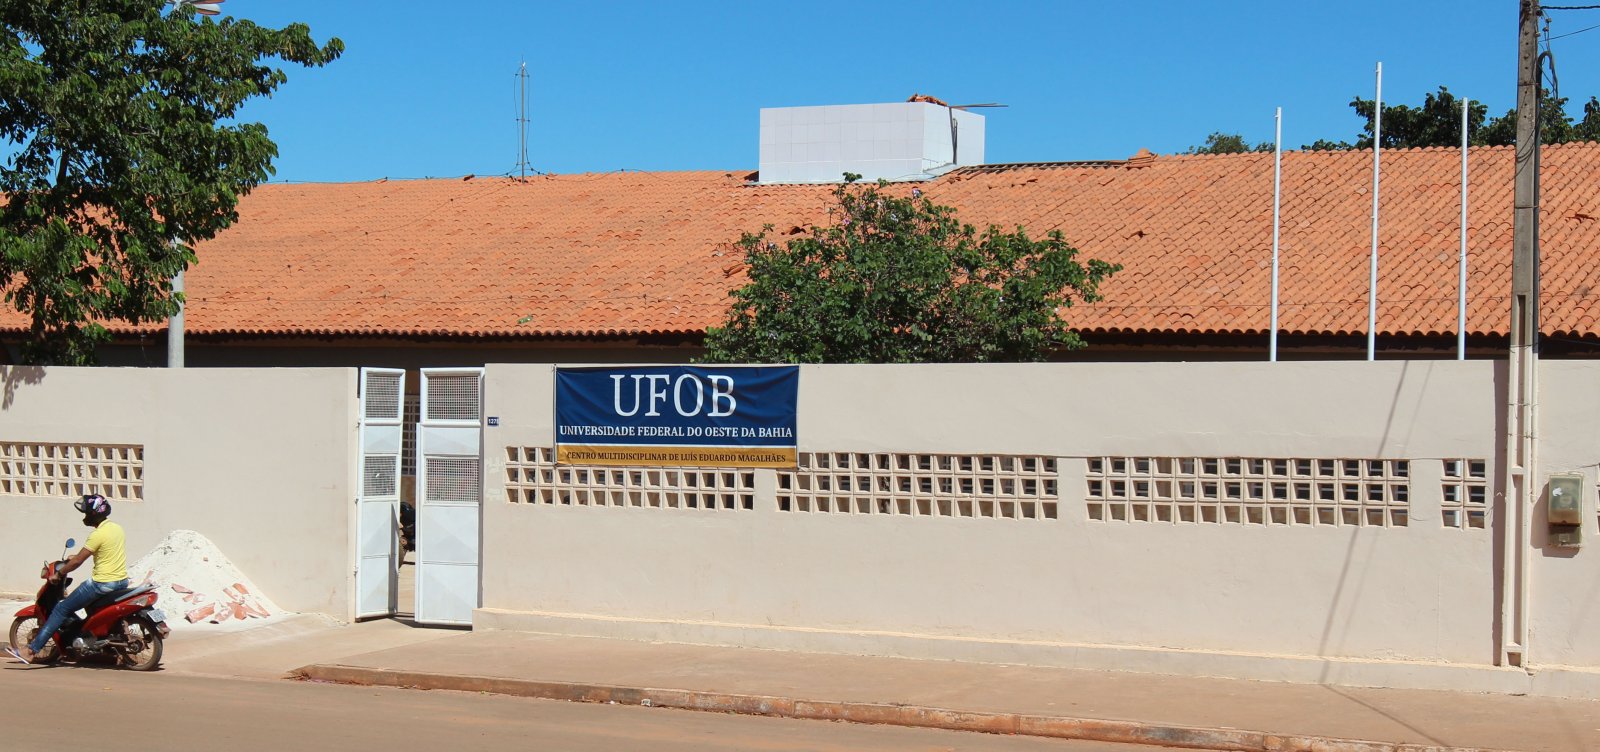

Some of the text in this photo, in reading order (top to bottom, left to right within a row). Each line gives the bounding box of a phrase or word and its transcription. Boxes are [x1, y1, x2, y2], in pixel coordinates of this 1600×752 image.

[609, 373, 737, 417] UFOB
[560, 425, 793, 438] UNIVERSIDADE FEDERAL DO OESTE DA BAHIA
[567, 451, 786, 463] CENTRO MULTIDISCIPLINAR DE LUÍS EDUARDO MAGALHÃES
